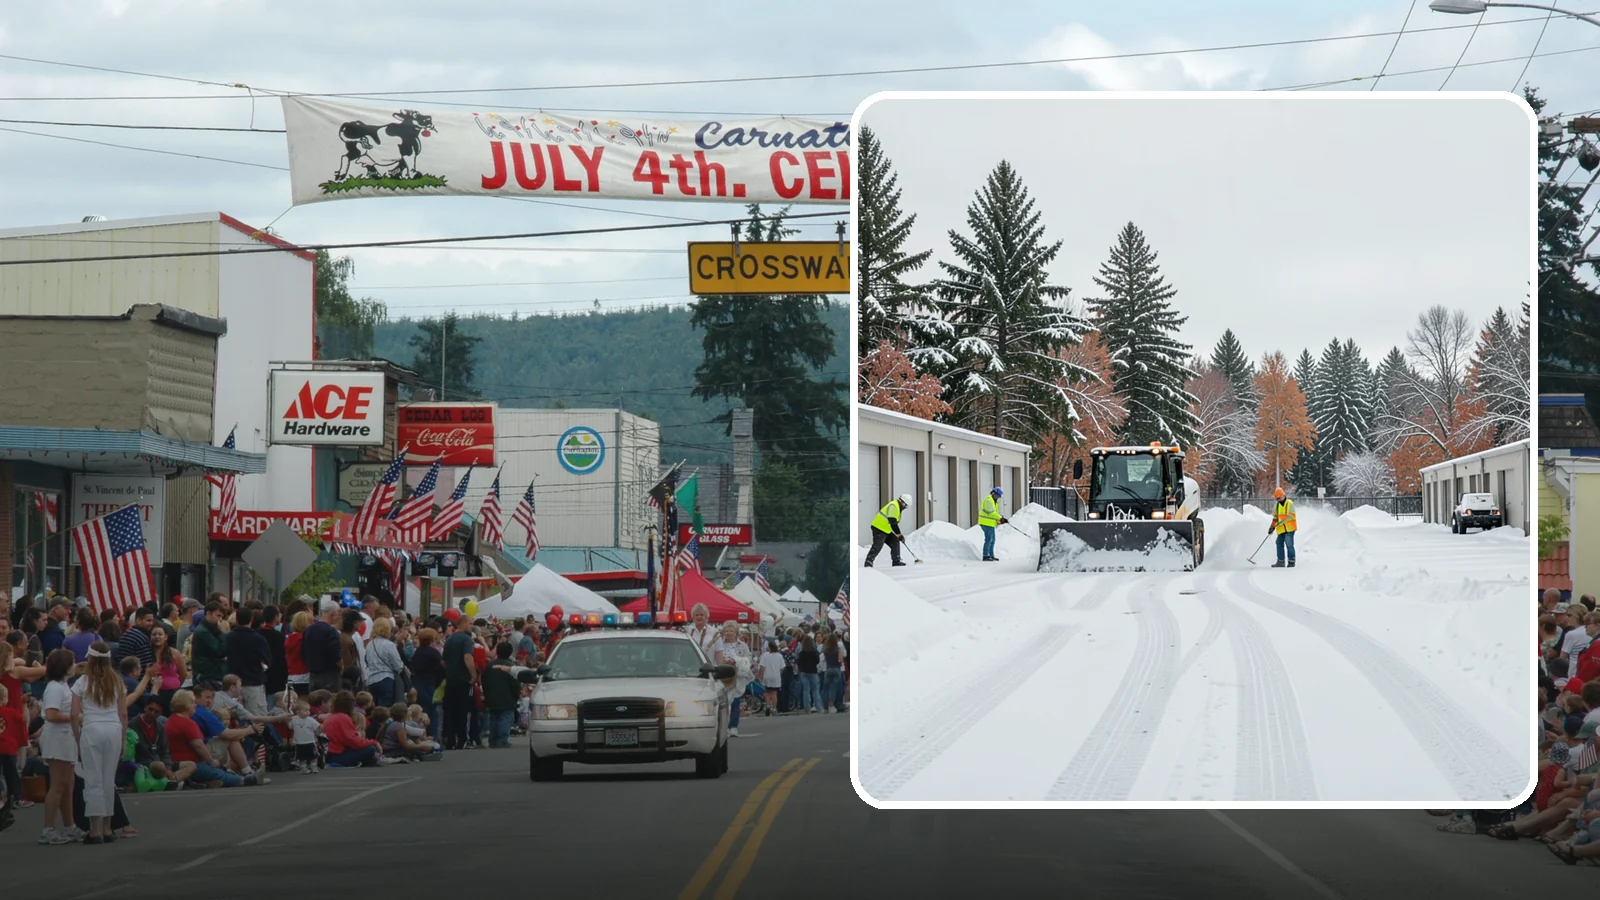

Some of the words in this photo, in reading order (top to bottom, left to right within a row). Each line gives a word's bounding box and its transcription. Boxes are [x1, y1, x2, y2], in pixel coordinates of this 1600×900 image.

[695, 122, 850, 149] Carnat
[481, 140, 605, 192] JULY
[632, 150, 746, 198] 4th.
[697, 254, 850, 279] CROSSWA
[282, 380, 374, 420] ACE
[405, 409, 453, 421] CEDAR
[283, 421, 371, 436] Hardware
[416, 428, 477, 447] Coca-Cola
[95, 485, 124, 495] Vincent
[126, 485, 136, 495] de
[138, 485, 155, 495] Paul
[688, 526, 742, 535] CRNATION
[699, 535, 730, 544] GLASS
